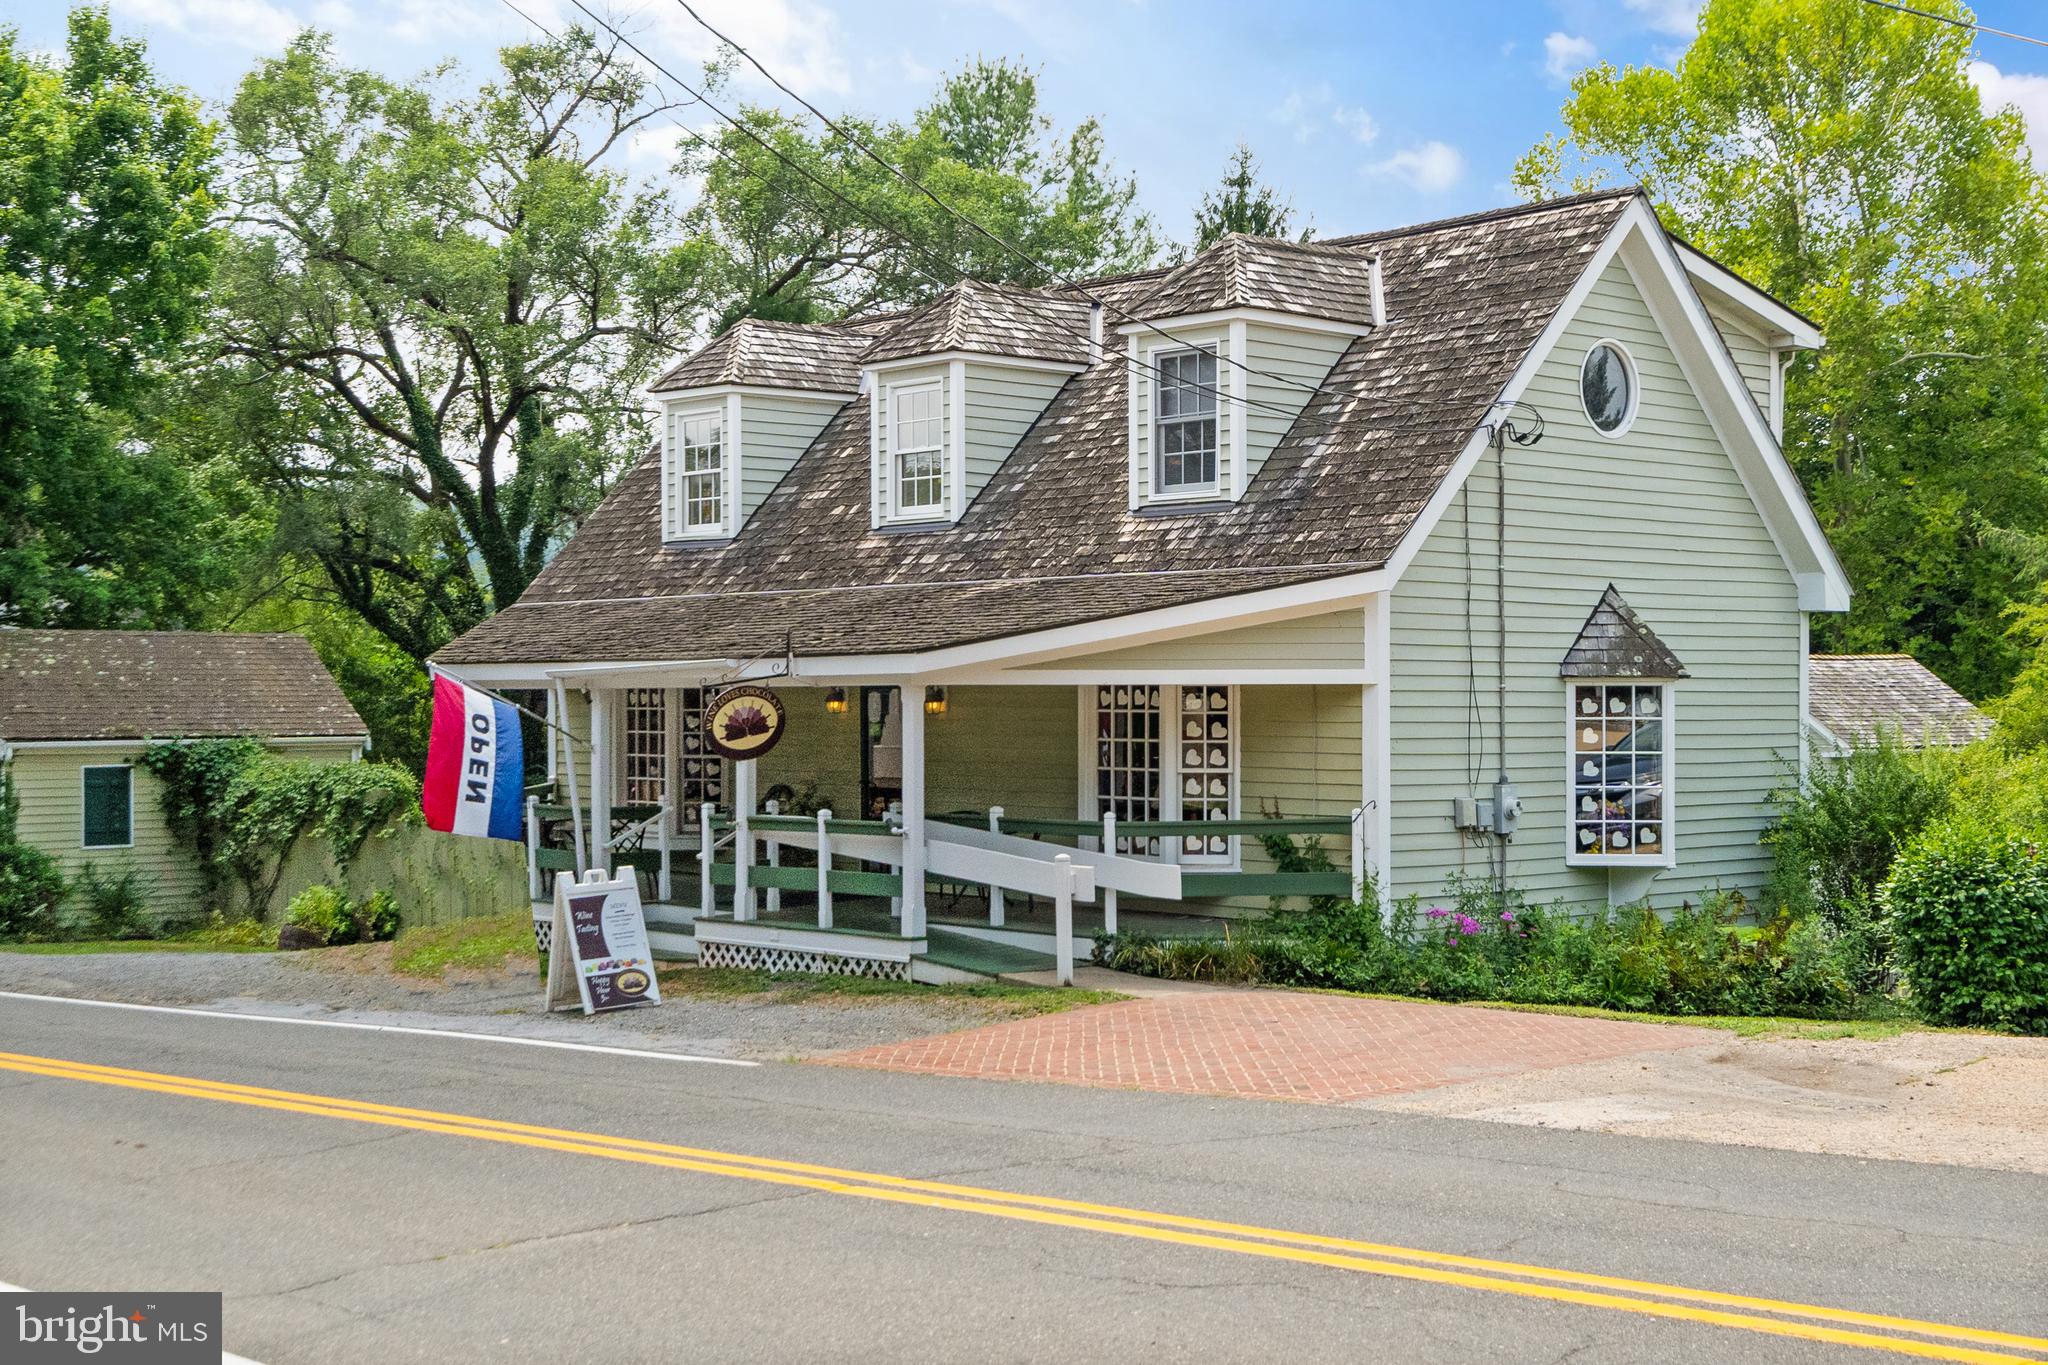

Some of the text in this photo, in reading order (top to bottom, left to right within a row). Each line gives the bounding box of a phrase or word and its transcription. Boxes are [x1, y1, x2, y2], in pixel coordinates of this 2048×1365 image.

[705, 688, 783, 730] WINE LOVES CHOCOLATE
